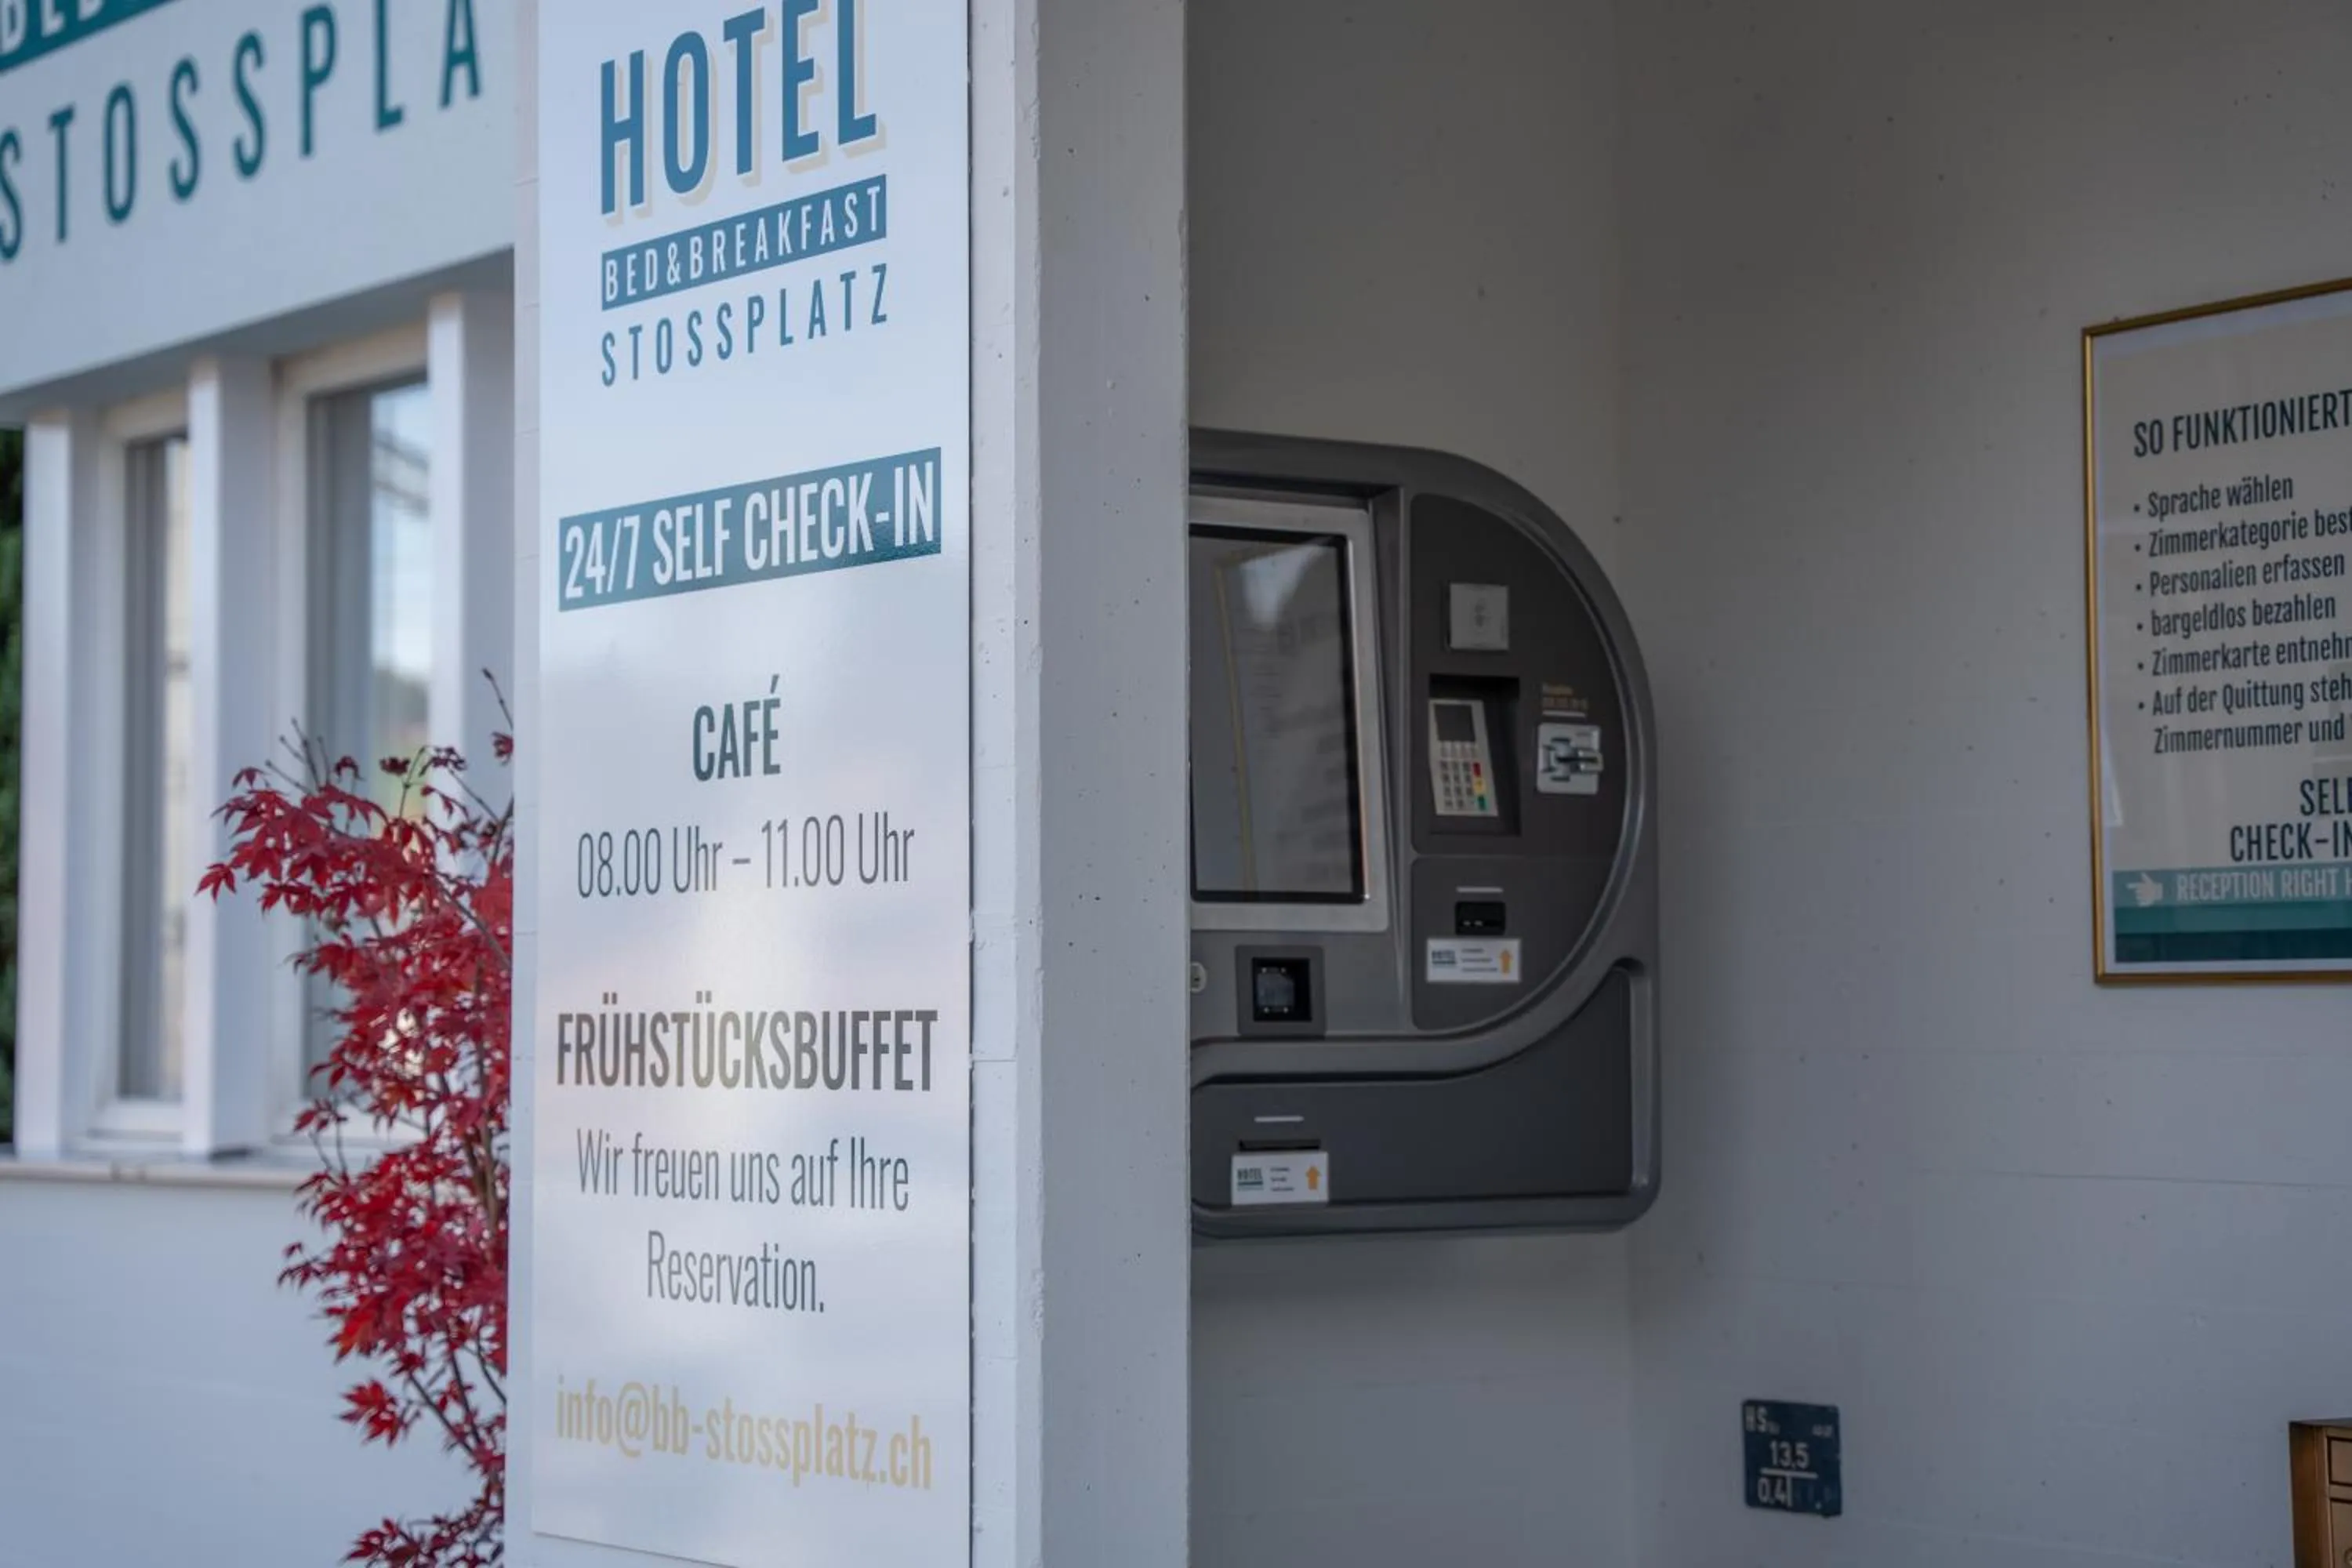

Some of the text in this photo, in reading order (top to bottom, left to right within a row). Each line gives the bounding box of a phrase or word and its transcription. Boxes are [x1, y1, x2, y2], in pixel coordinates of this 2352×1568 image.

[601, 0, 886, 225] HOTEL
[605, 185, 881, 302] BED&BREAKFAST
[601, 263, 887, 387] STOSSPLATZ
[2133, 389, 2352, 458] SO FUNKTIONIERT
[564, 461, 934, 599] 24/7 SELF CHECK-IN
[2147, 474, 2294, 523] Sprache wählen
[2148, 510, 2308, 557] Zimmerkategorie
[2150, 553, 2346, 597] Personalien erfassen
[2151, 593, 2336, 639] bargeldlos bezahlen
[2152, 639, 2270, 677] Zimmerkarte
[2152, 685, 2182, 716] Auf
[2187, 684, 2218, 713] der
[2223, 679, 2304, 715] Quittung
[692, 673, 782, 782] CAFÉ
[2154, 712, 2345, 754] Zimmernummer und
[578, 828, 662, 898] 08.00
[673, 826, 723, 894] Uhr
[761, 814, 844, 889] 11.00
[858, 811, 915, 884] Uhr
[2176, 869, 2274, 902] RECEPTION
[2281, 866, 2339, 900] RIGHT
[557, 990, 938, 1091] FRÜHSTÜCKSBUFFET
[577, 1128, 909, 1211] Wir freuen uns auf Ihre
[648, 1230, 826, 1313] Reservation.
[557, 1375, 932, 1491] info@bb-stossplatz.ch
